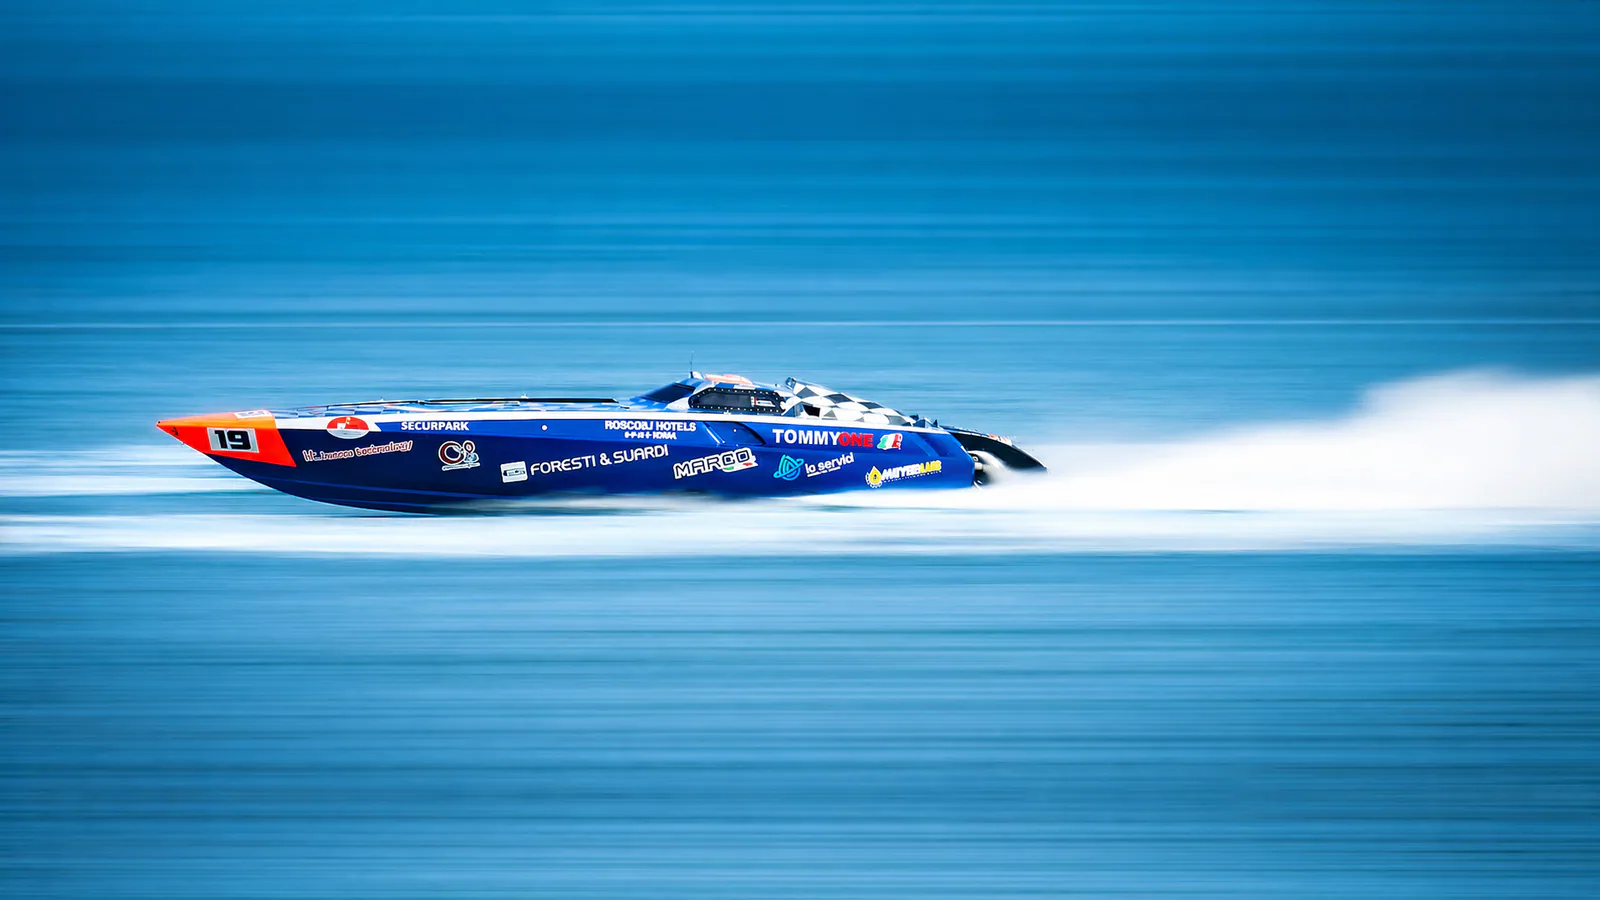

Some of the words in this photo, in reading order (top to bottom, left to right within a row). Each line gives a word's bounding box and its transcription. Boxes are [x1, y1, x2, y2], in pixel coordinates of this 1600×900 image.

[400, 421, 470, 431] SECURPARK
[655, 421, 697, 431] HOTELS
[214, 429, 251, 450] 19
[530, 455, 596, 475] FORESTI
[599, 453, 612, 466] &
[612, 444, 669, 464] SUARDI
[673, 448, 751, 479] MARCO
